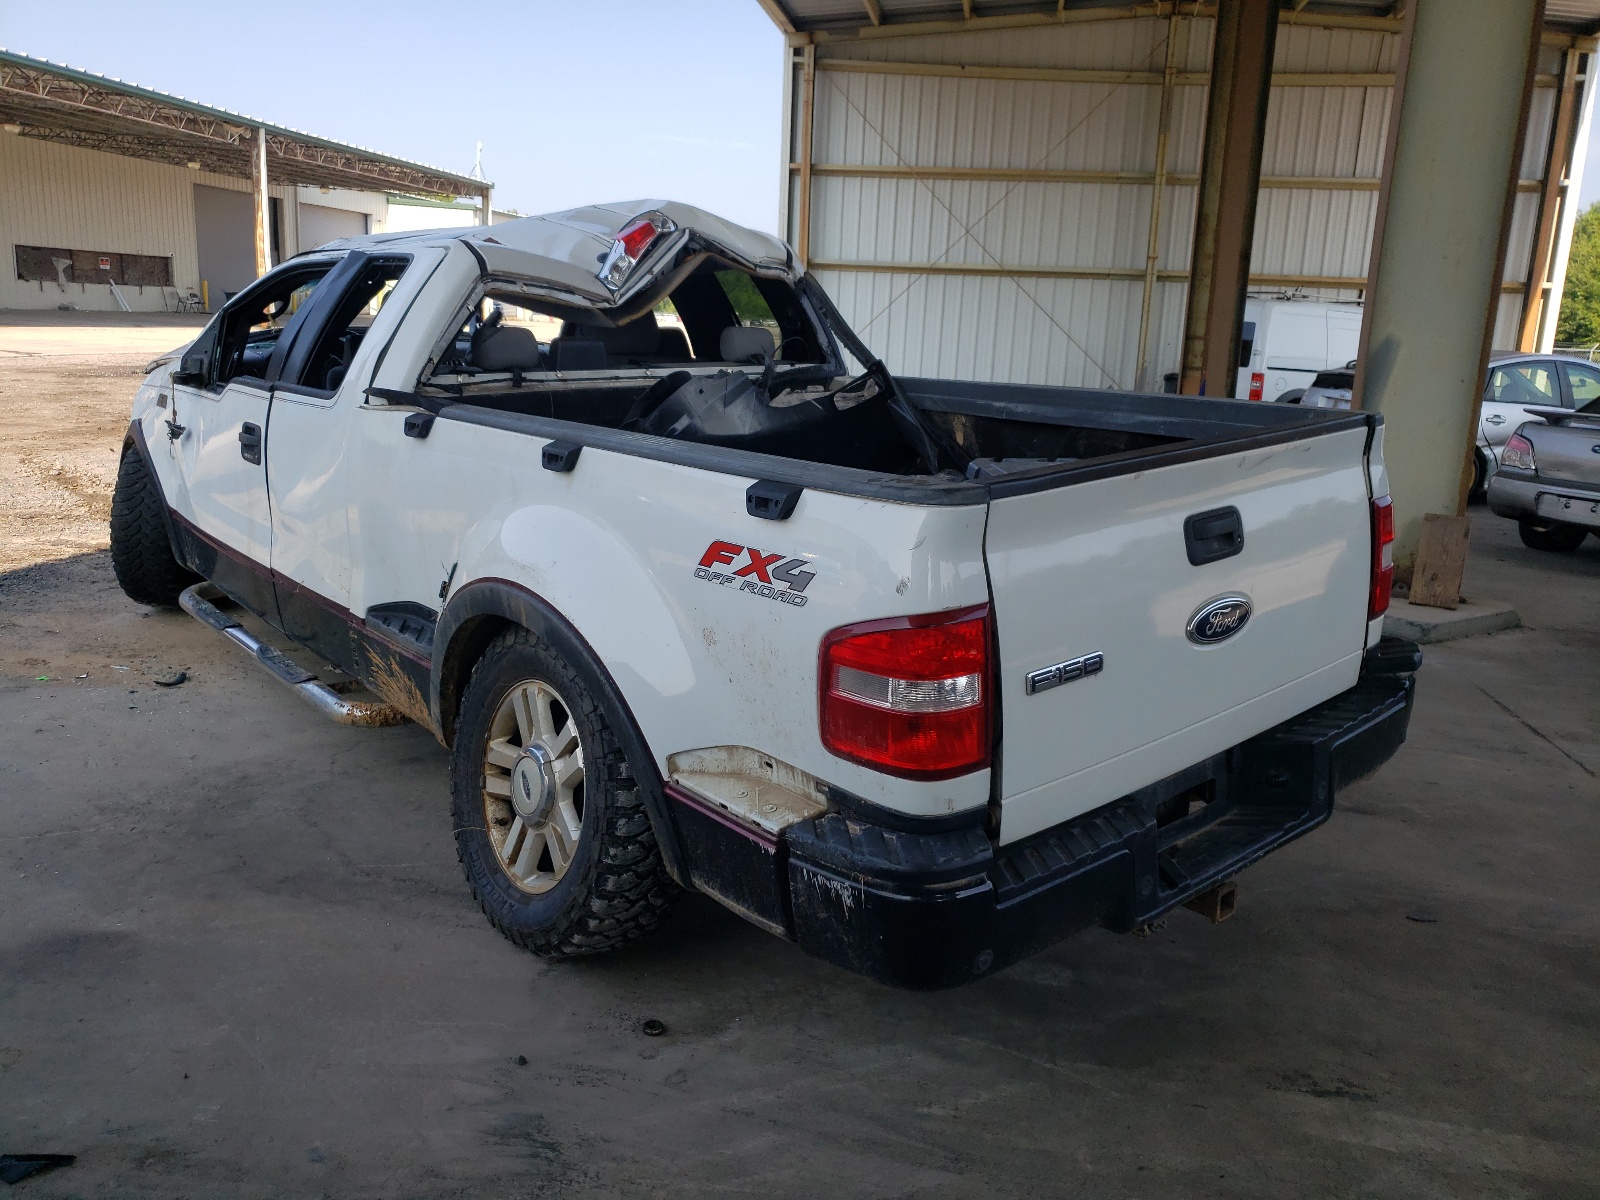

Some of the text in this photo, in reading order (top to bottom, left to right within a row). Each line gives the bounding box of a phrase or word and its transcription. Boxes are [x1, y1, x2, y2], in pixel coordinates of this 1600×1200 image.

[697, 540, 818, 593] FX4
[693, 567, 809, 608] OFF ROAD
[1205, 607, 1240, 636] Ford
